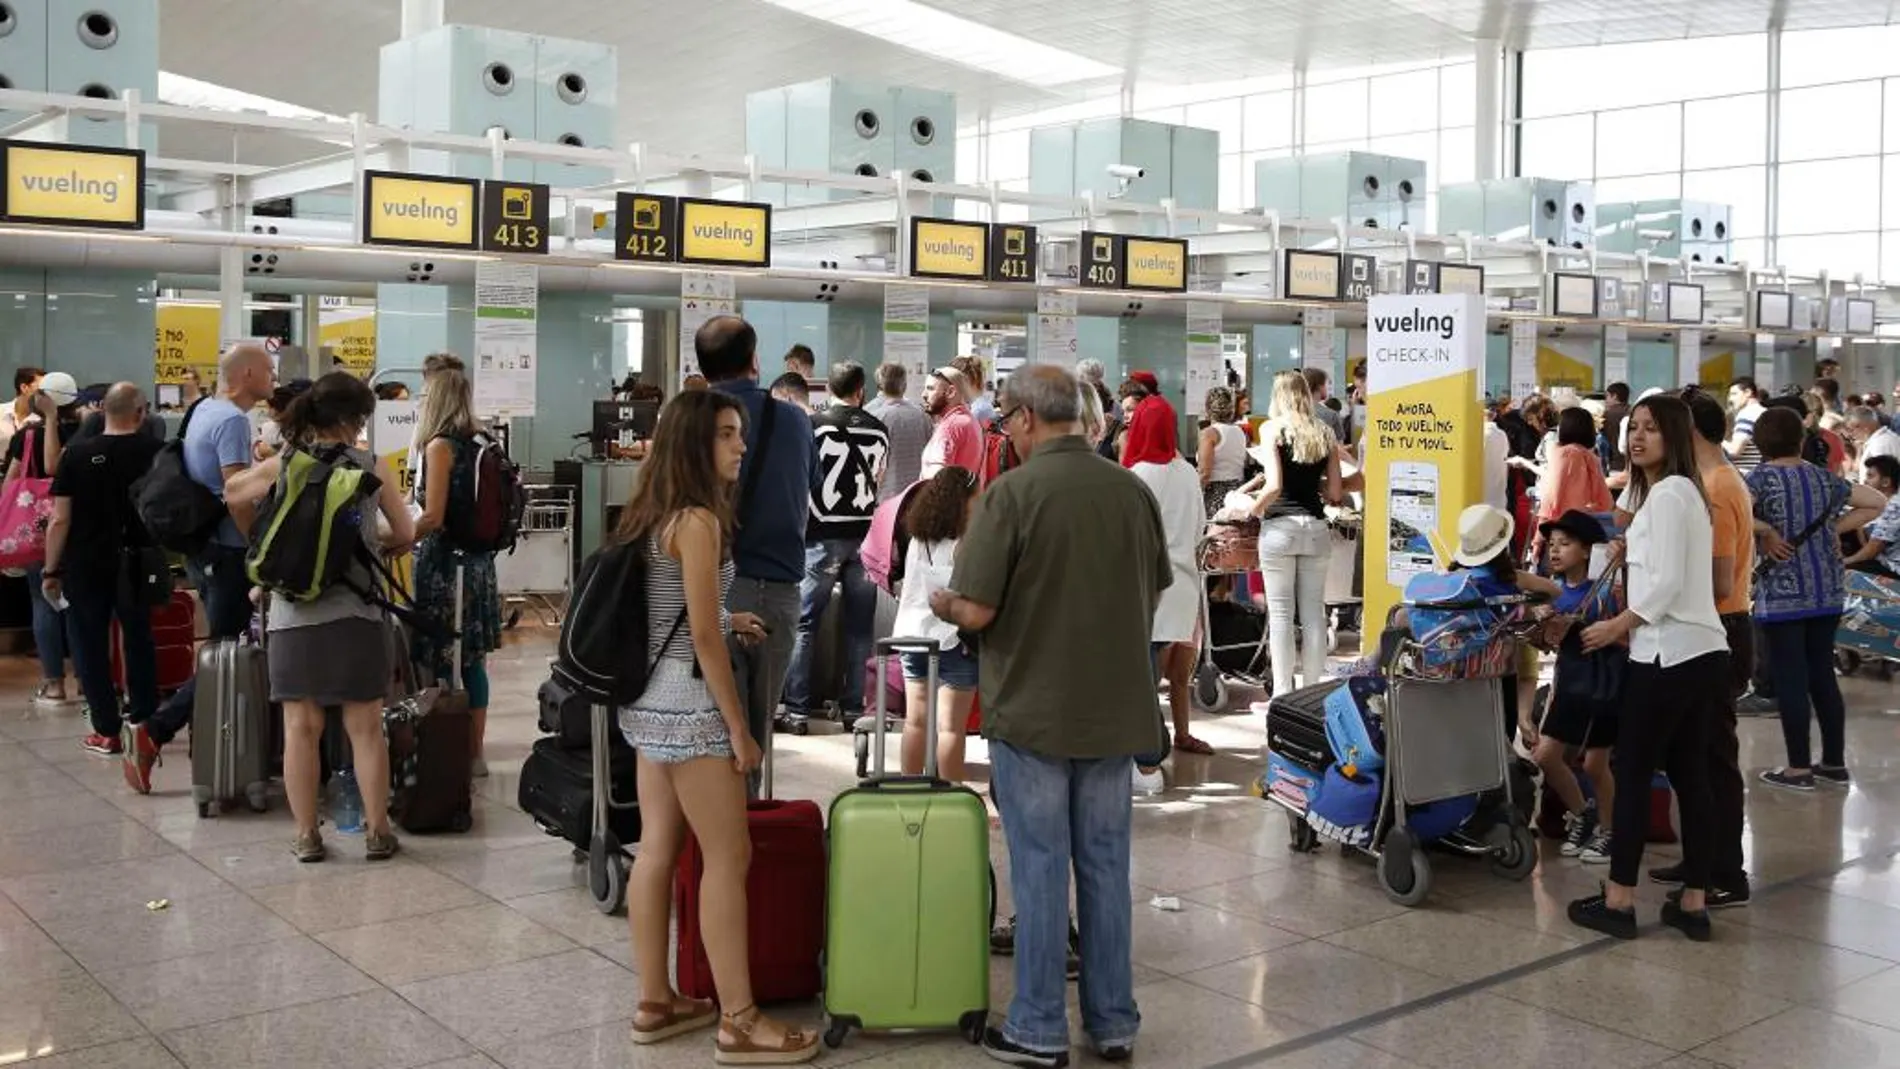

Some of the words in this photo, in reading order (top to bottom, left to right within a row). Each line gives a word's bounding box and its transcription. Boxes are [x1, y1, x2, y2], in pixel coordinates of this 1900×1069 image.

[22, 169, 118, 204] vueling
[383, 196, 459, 227] vueling
[494, 224, 540, 248] 413
[693, 220, 753, 246] vueling
[626, 234, 666, 257] 412
[924, 239, 974, 260] vueling
[1000, 259, 1029, 278] 411
[1088, 265, 1115, 285] 410
[1133, 255, 1176, 276] vueling
[1375, 307, 1454, 339] vueling
[1376, 347, 1450, 363] CHECK-IN
[1376, 420, 1402, 432] TODO
[1406, 418, 1453, 434] VUELING
[1380, 435, 1394, 448] EN
[1398, 436, 1412, 449] TU
